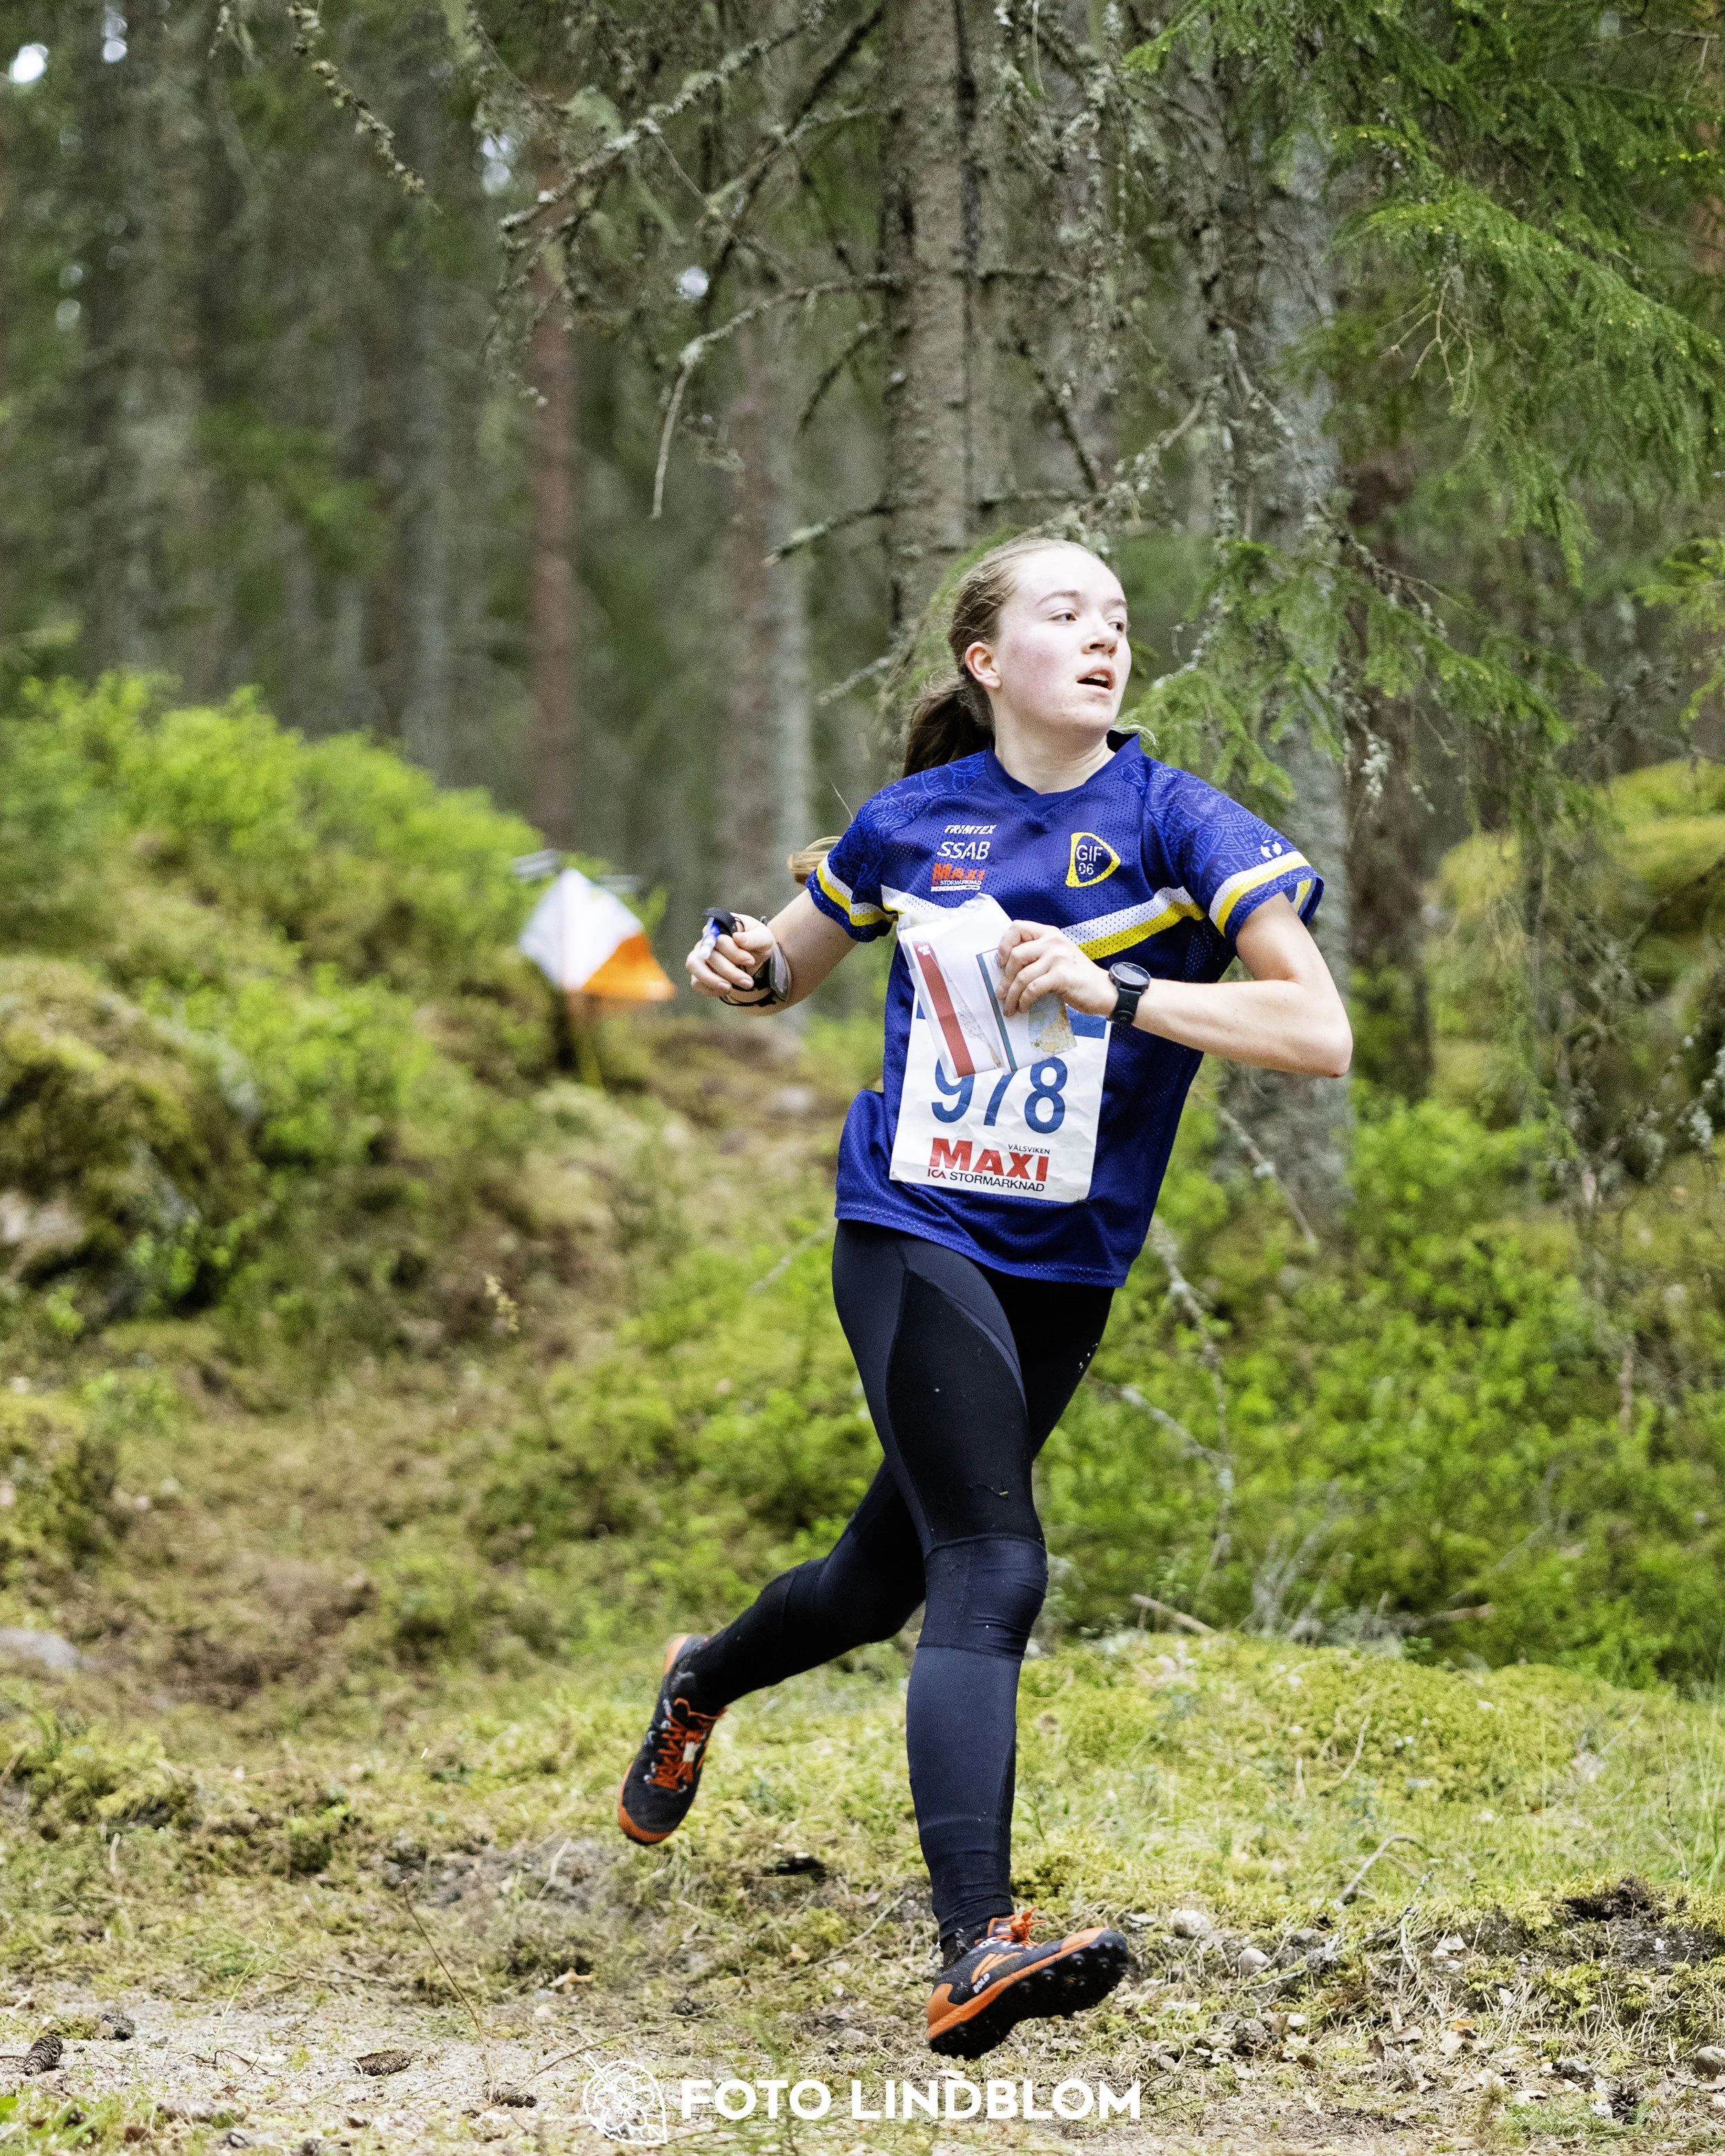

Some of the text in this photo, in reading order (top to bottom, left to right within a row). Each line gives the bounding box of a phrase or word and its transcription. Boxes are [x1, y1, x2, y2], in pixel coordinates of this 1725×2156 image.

[944, 824, 997, 834] TRIMTEX
[937, 841, 991, 860] SSAB
[1076, 844, 1103, 862] GIF
[1078, 862, 1094, 875] 06
[931, 1056, 1067, 1134] 978
[1008, 1144, 1050, 1154] VÄLSVIKEN
[929, 1137, 1049, 1182] MAXI
[927, 1169, 1045, 1192] ICA STORMARKNAD
